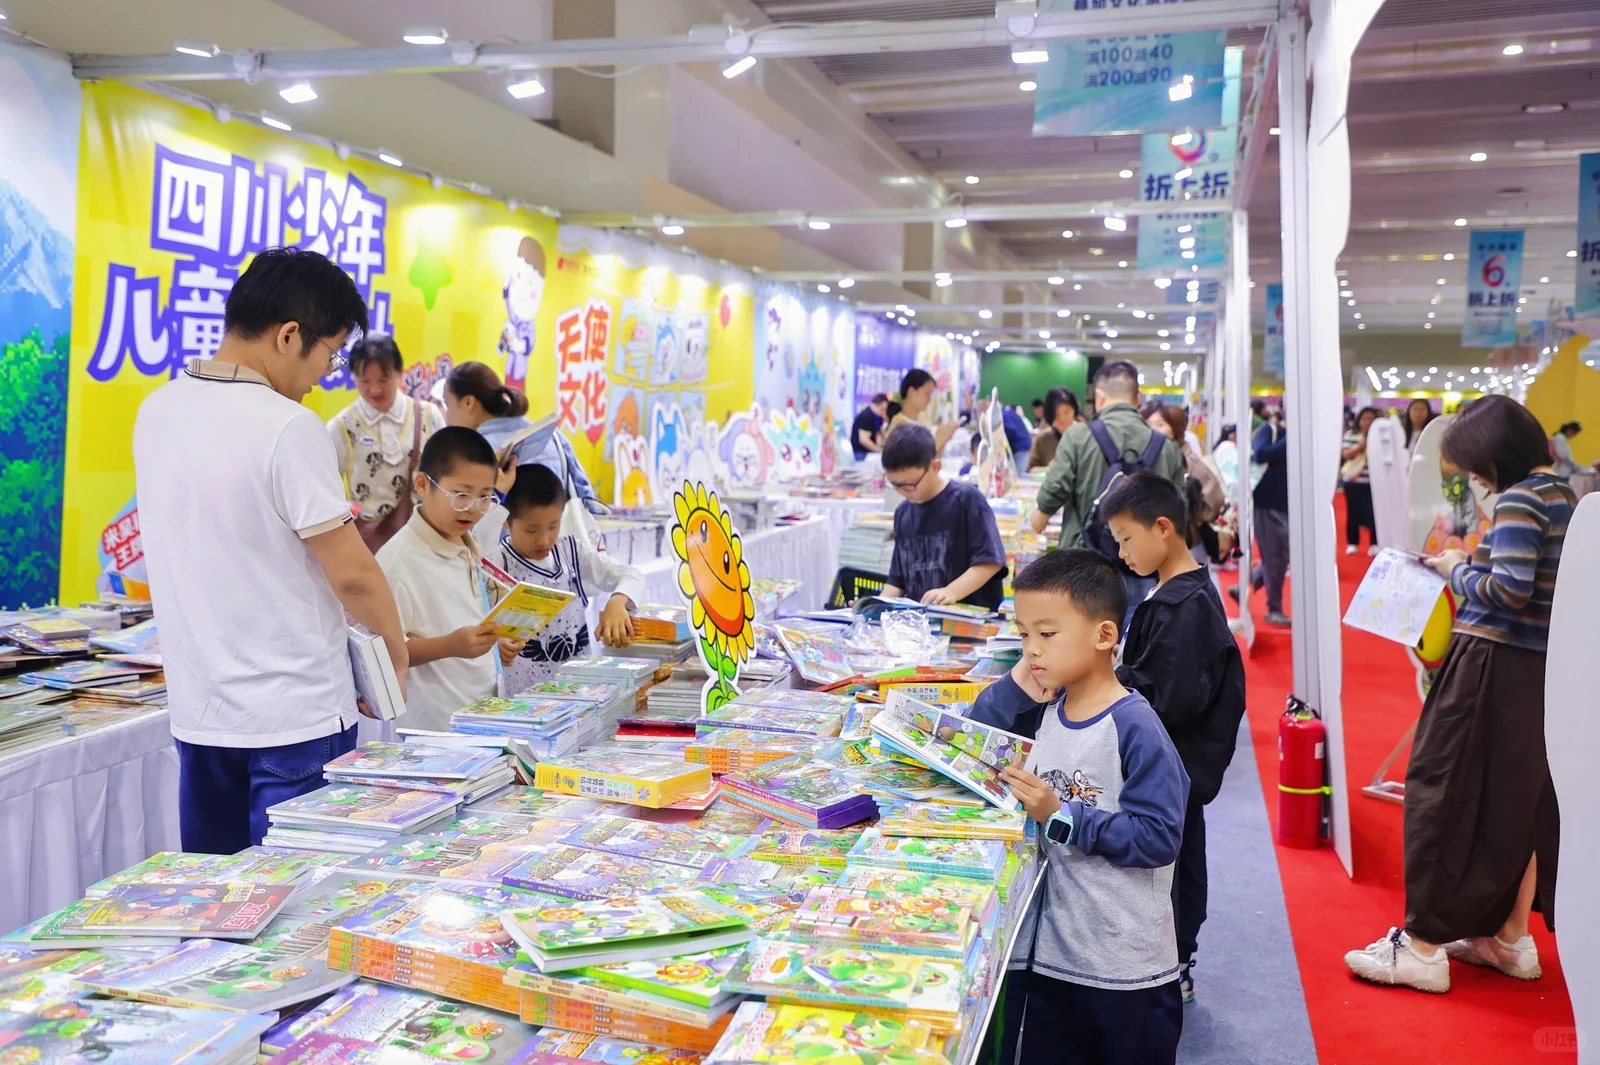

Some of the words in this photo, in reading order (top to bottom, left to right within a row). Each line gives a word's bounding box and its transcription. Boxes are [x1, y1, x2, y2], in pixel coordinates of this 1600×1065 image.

[152, 143, 387, 286] 四川少年
[1482, 253, 1508, 288] 6
[556, 371, 607, 430] 文化
